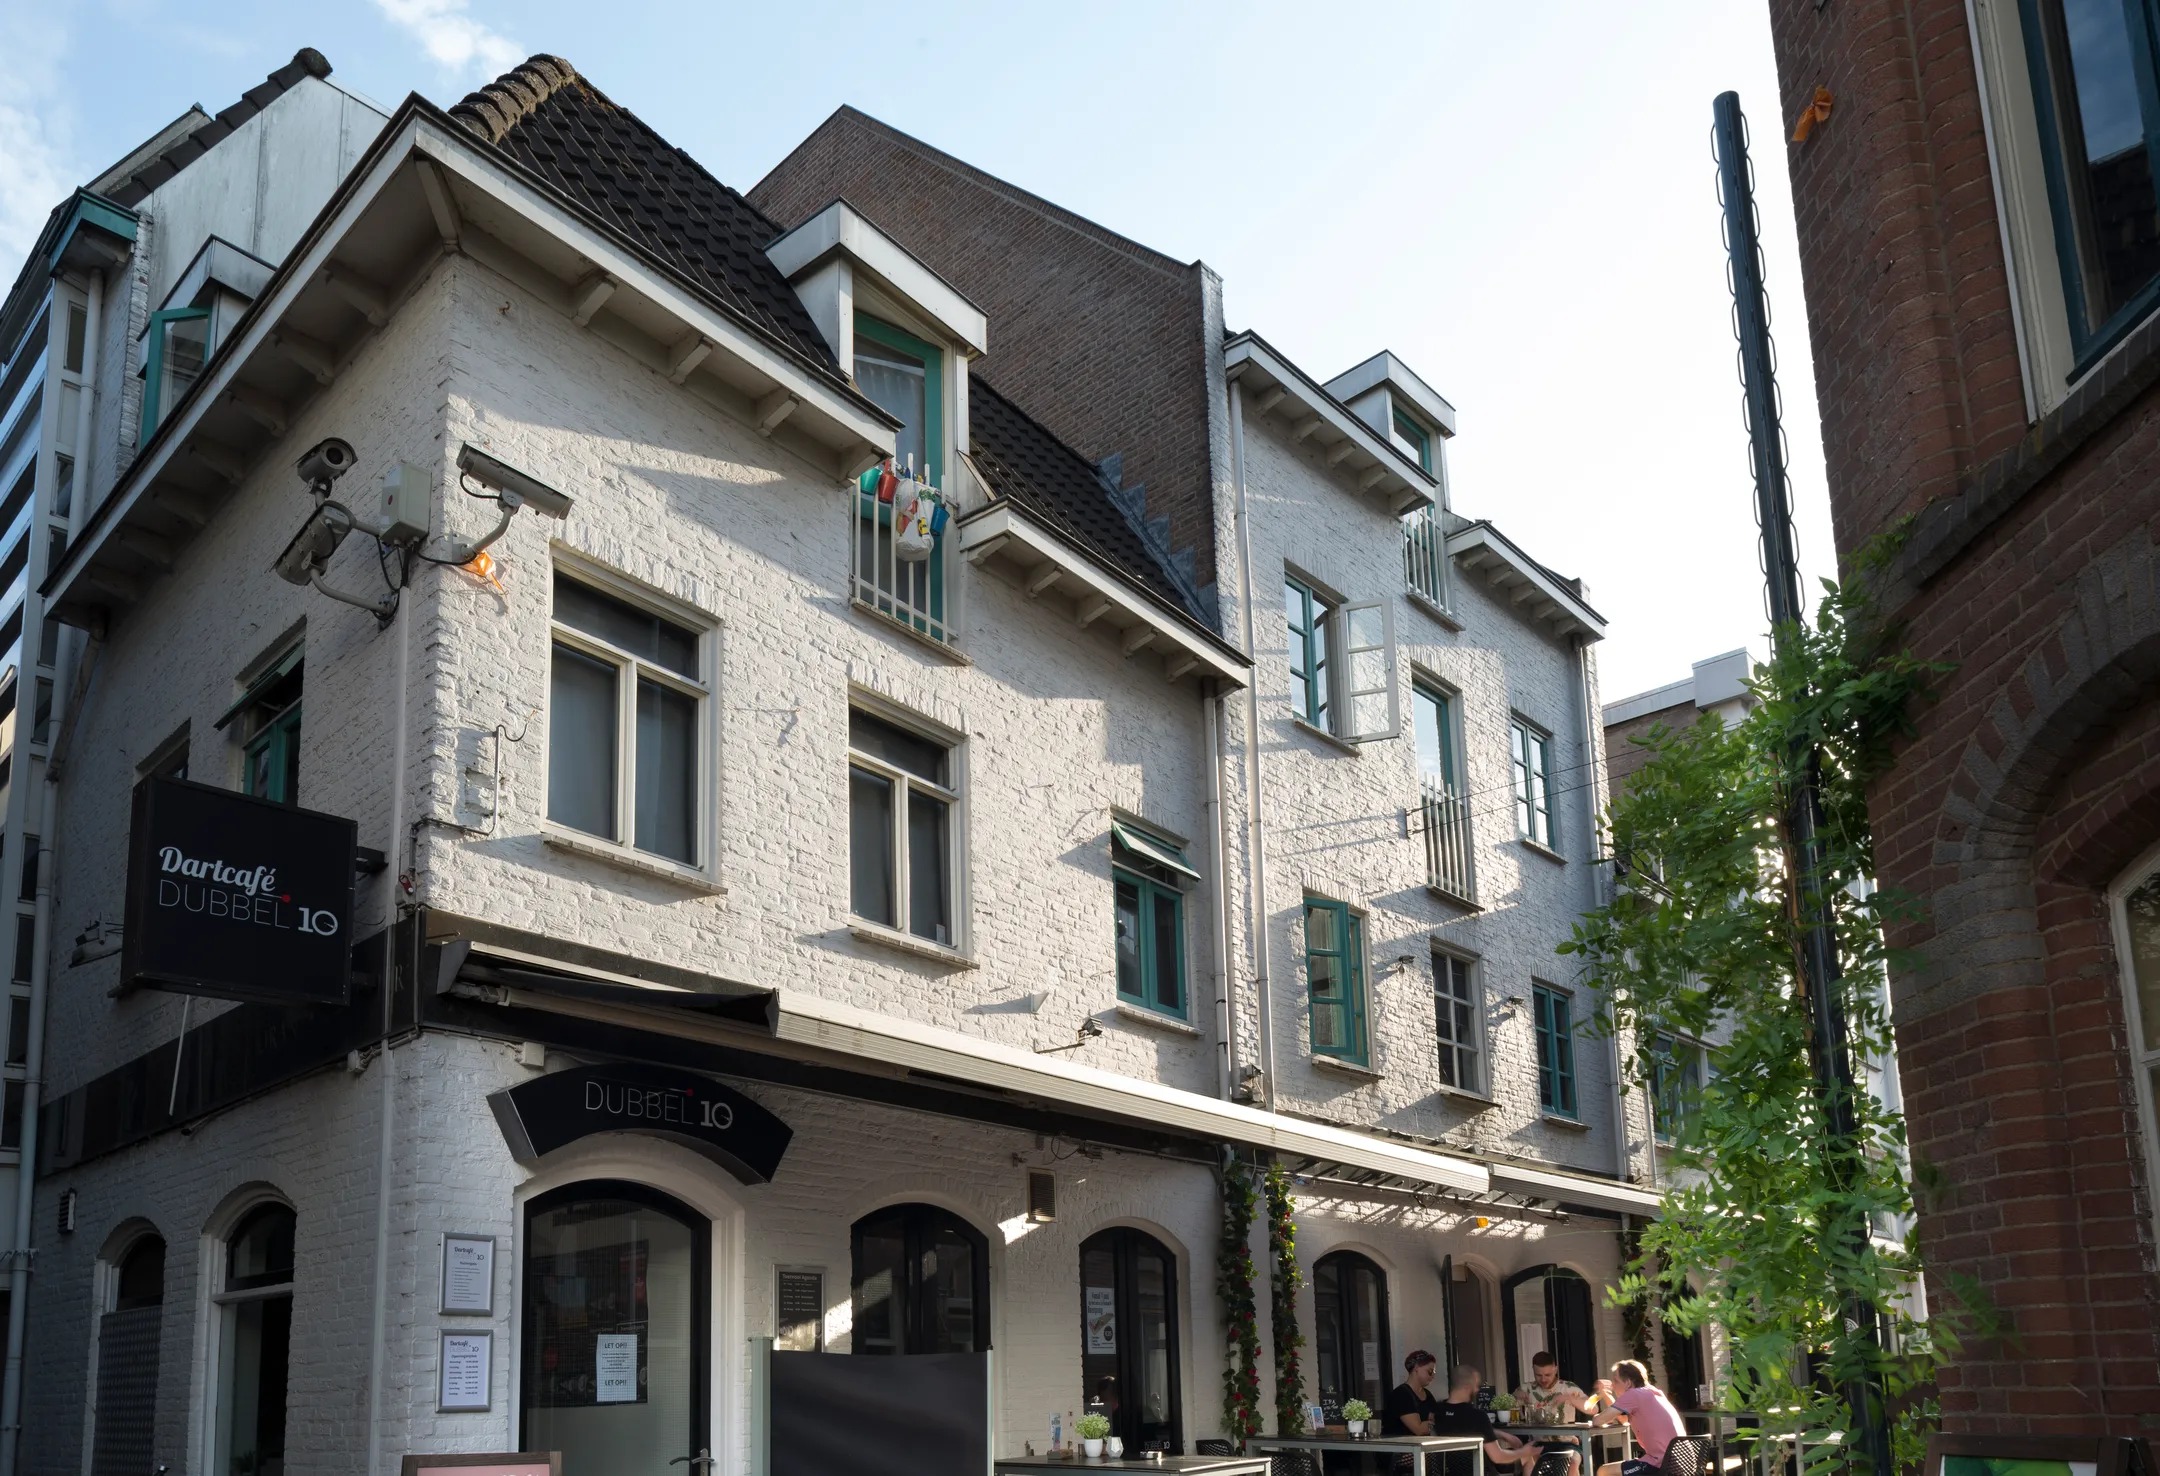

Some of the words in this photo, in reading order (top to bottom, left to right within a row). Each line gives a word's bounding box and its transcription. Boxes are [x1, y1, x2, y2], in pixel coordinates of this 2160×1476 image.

[159, 846, 276, 896] Dartcafé
[159, 879, 290, 929] DUBBEL
[298, 907, 338, 936] 10
[585, 1081, 694, 1125] DUBBEL
[700, 1100, 733, 1130] 10
